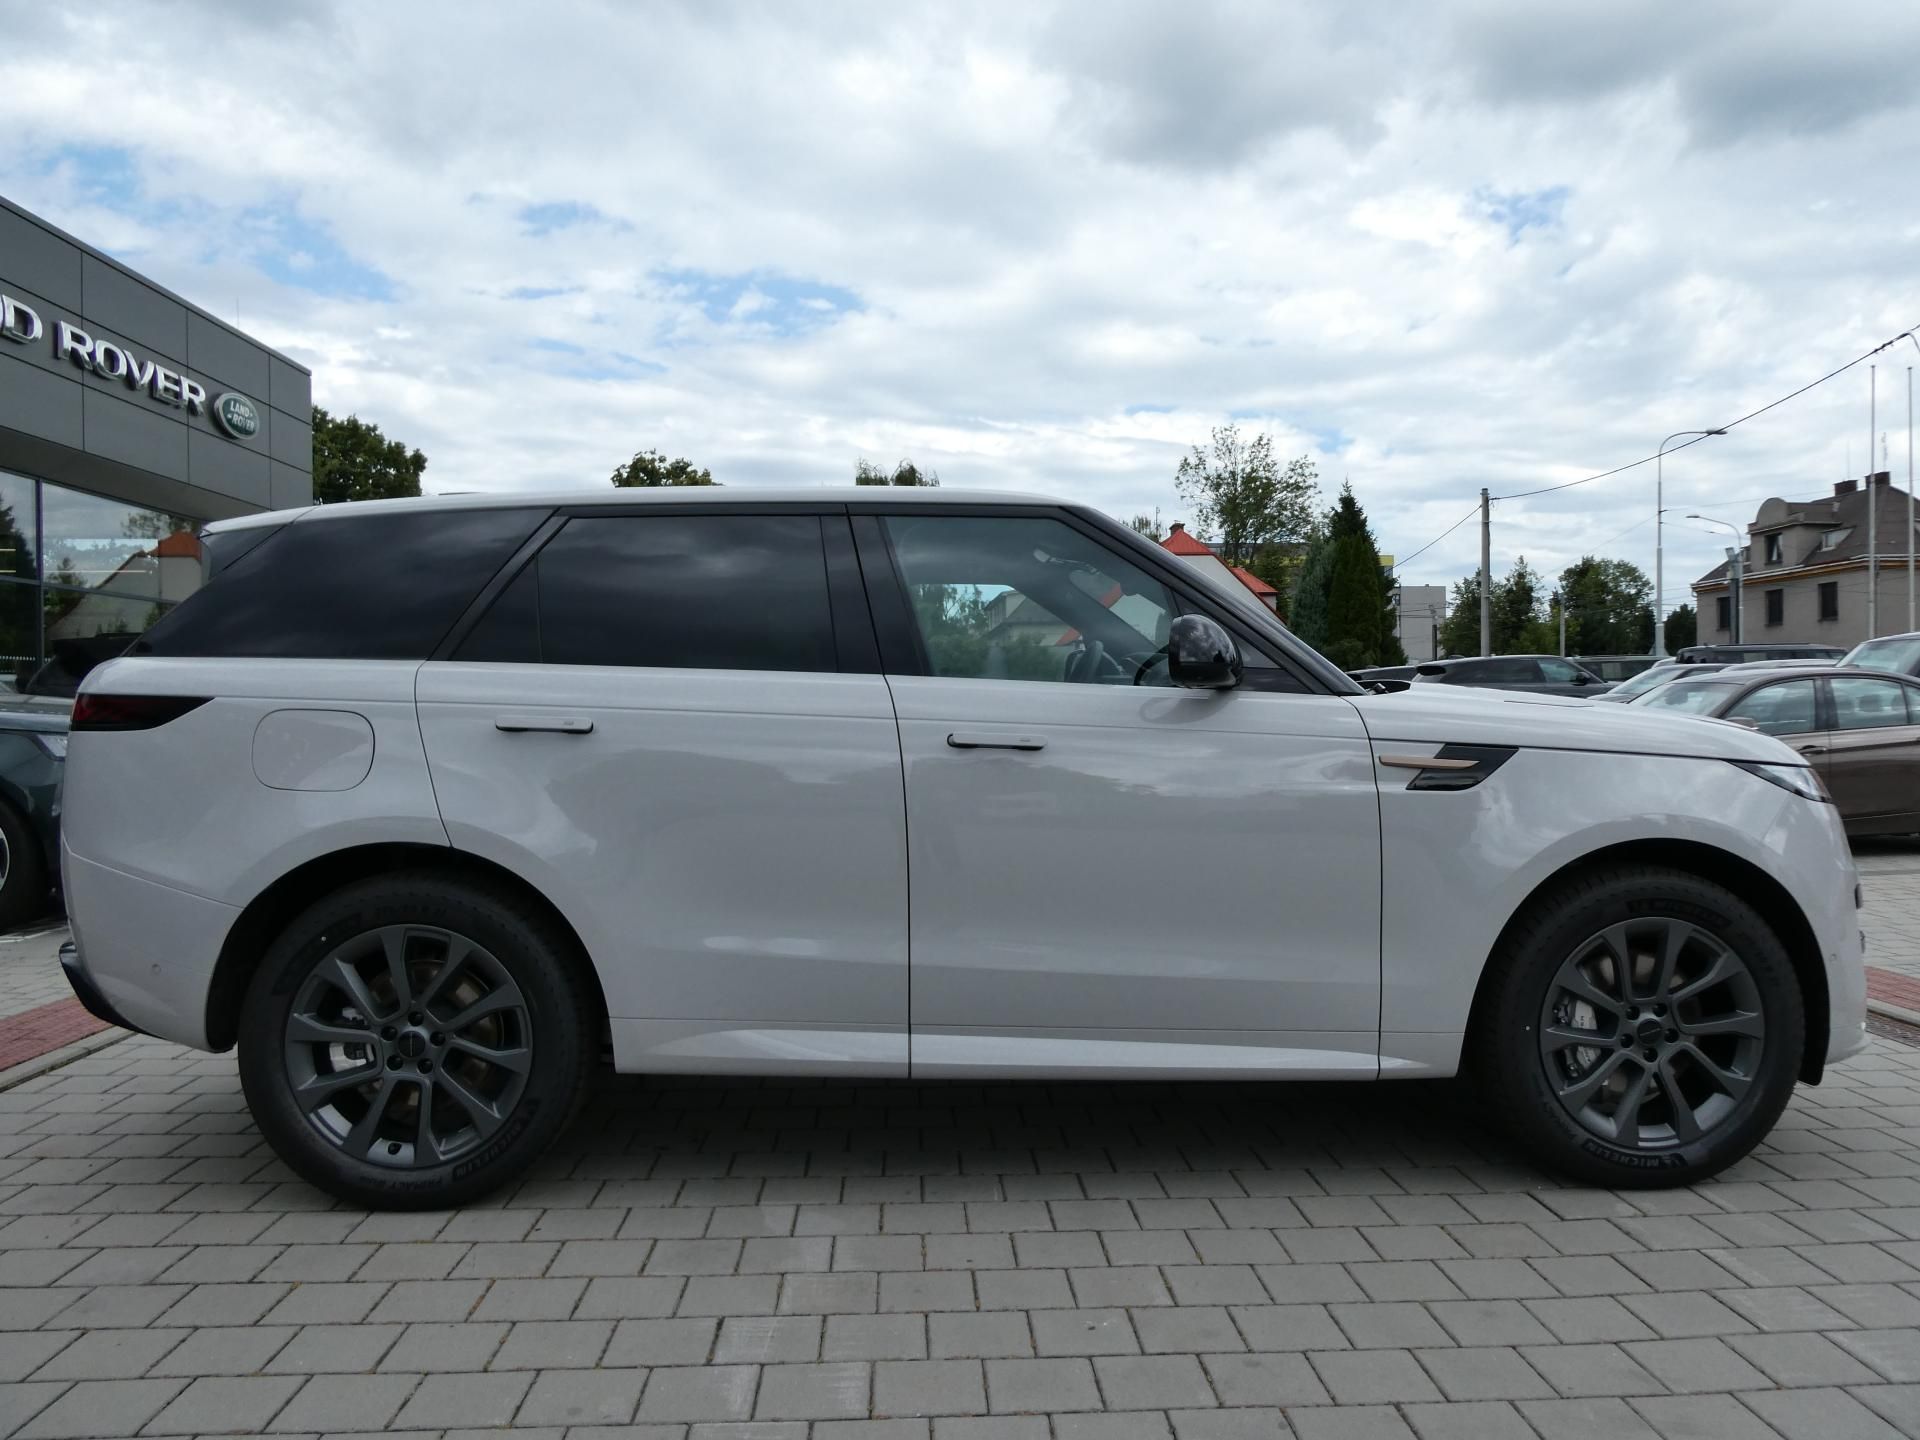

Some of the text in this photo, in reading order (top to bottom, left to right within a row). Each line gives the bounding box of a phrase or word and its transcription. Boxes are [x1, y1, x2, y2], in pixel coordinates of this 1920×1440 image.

[0, 293, 207, 416] D ROVER
[230, 400, 250, 417] LAND
[232, 413, 255, 432] ROVER
[1585, 1141, 1660, 1167] MICHELIN
